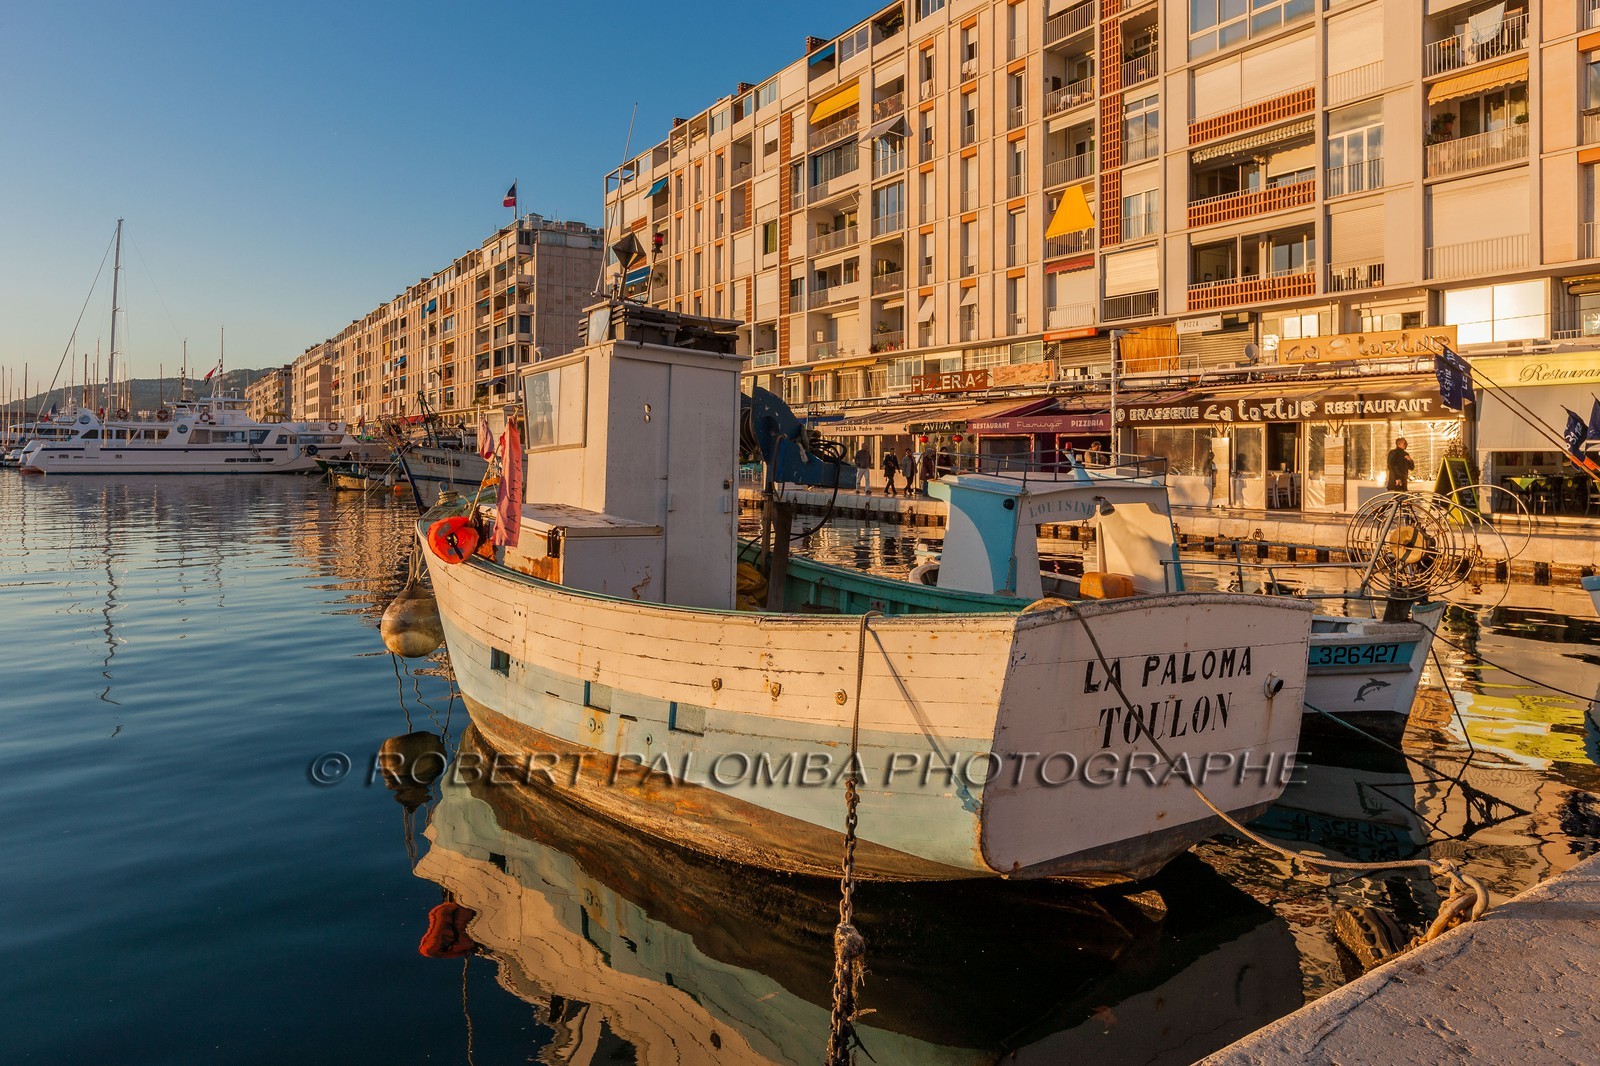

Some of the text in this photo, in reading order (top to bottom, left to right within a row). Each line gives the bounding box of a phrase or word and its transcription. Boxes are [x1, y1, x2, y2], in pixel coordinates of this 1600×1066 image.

[1183, 320, 1199, 328] PIZZA
[1129, 406, 1199, 421] BRASSERIE
[1324, 398, 1432, 415] RESTAURANT
[972, 422, 1010, 430] RESTAURANT
[1070, 418, 1104, 427] PIZZERIA
[1084, 646, 1253, 694] LA PALOMA
[1099, 692, 1233, 749] TOULON
